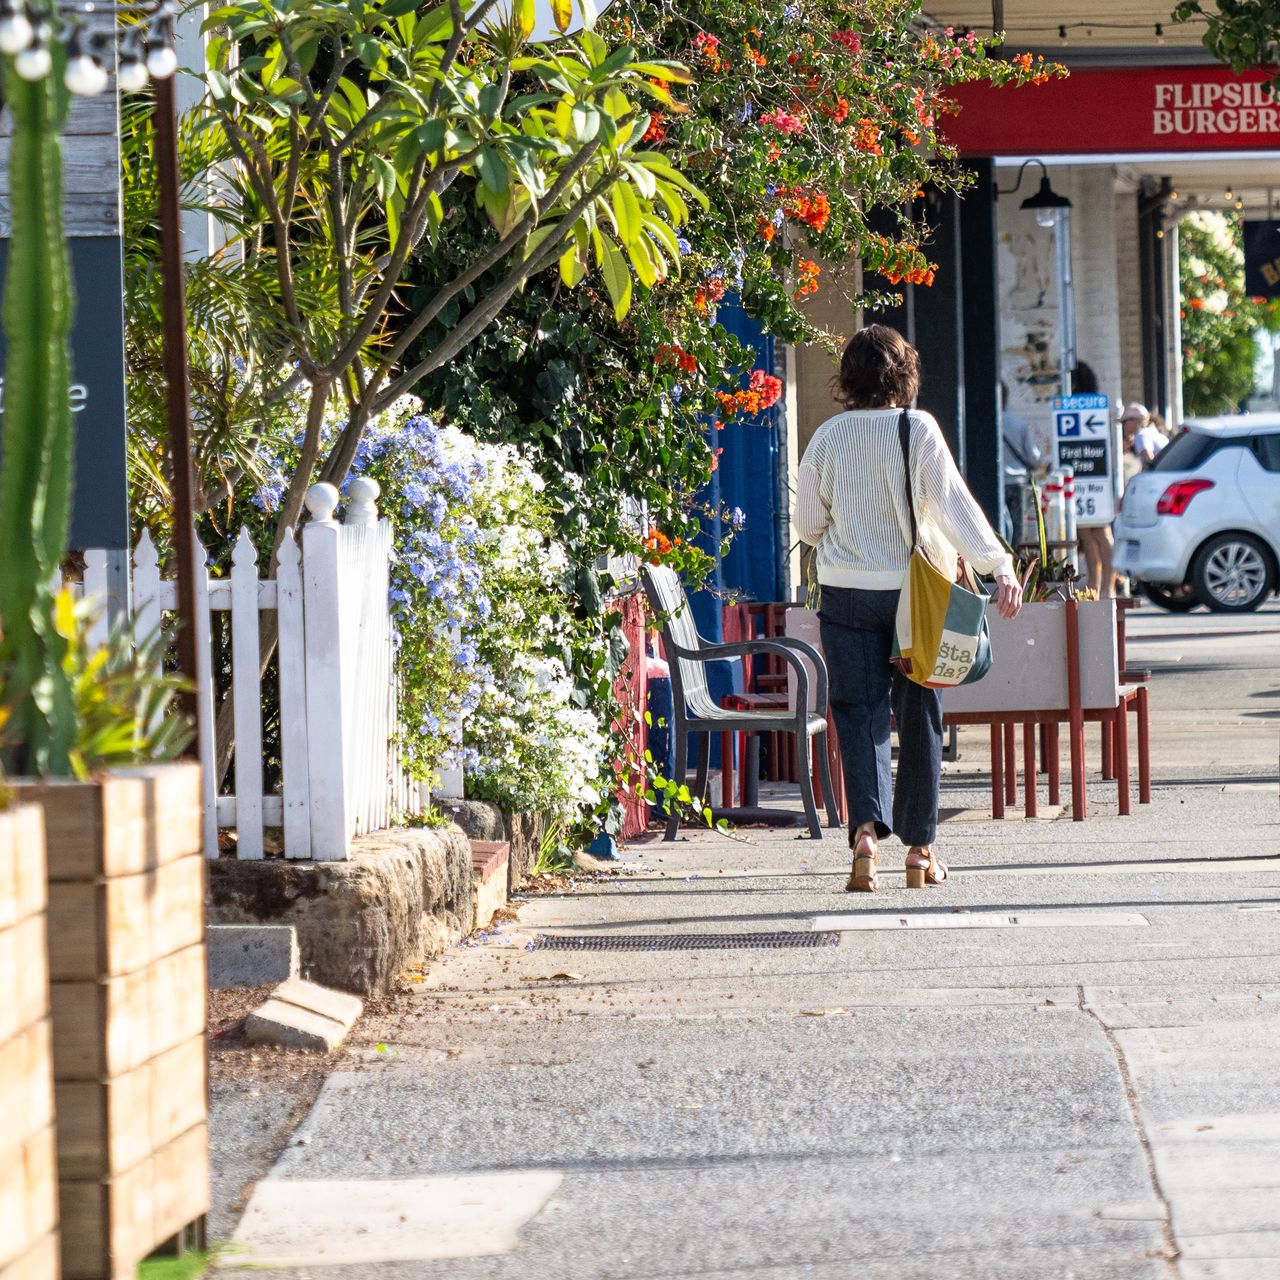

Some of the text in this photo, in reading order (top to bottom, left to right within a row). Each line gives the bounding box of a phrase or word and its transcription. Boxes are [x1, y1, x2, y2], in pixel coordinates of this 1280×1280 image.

[1062, 396, 1108, 411] secure
[1061, 415, 1076, 435] P
[1061, 445, 1105, 460] First Hour
[1073, 461, 1095, 472] Free
[1076, 499, 1096, 516] $6
